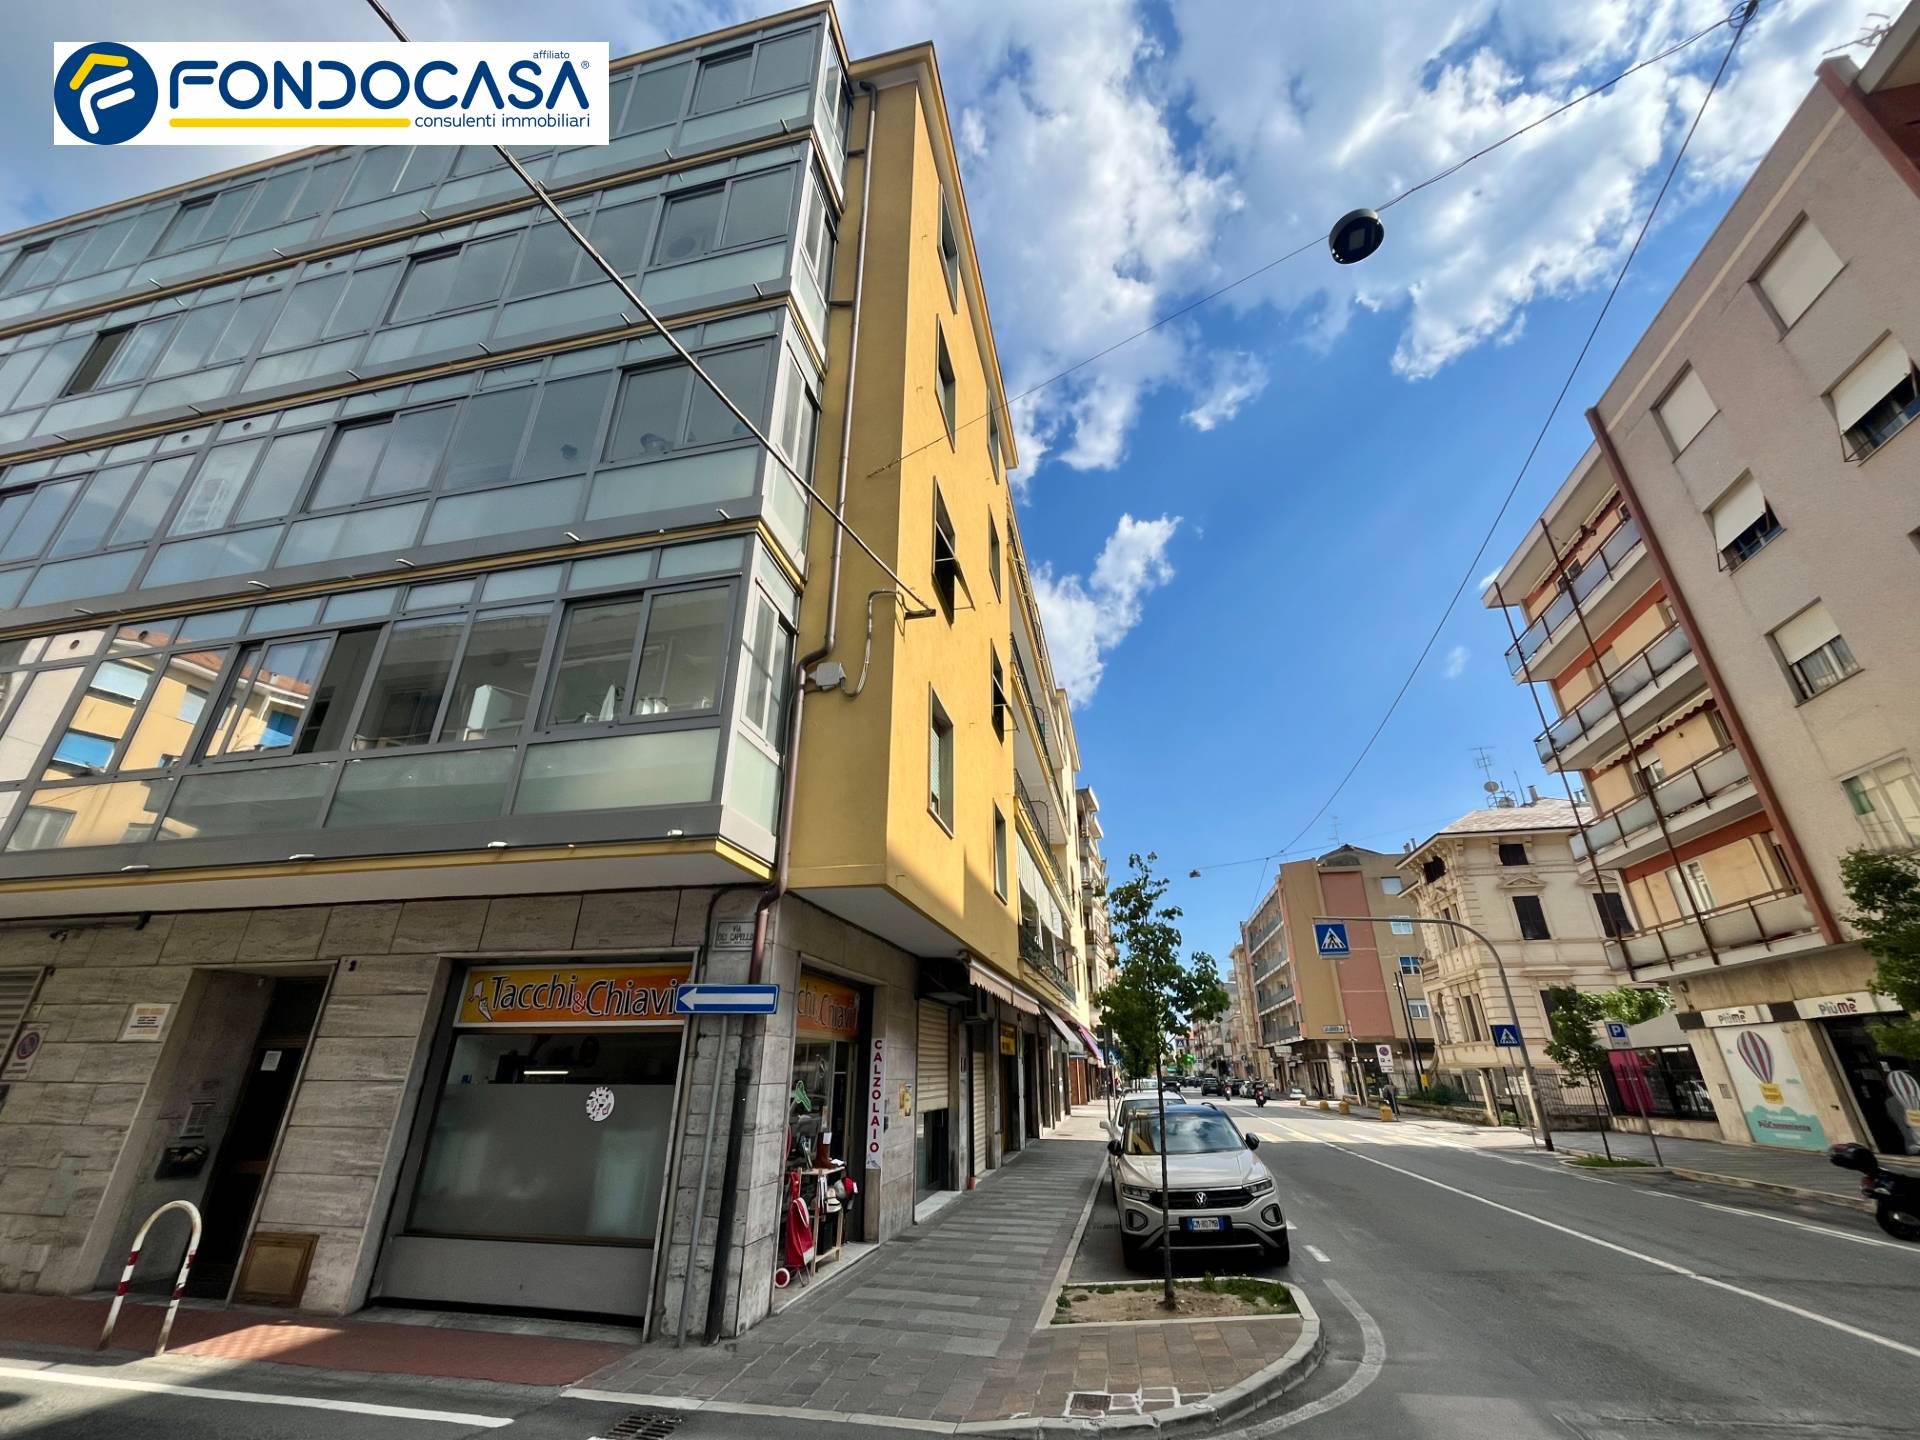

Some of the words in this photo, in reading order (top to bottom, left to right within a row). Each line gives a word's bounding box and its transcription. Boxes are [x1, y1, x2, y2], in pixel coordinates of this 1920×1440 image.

[491, 973, 578, 1011] Tacchi
[571, 991, 586, 1014] &
[585, 978, 679, 1017] Chiavi
[869, 1039, 883, 1153] CALZOLAIO
